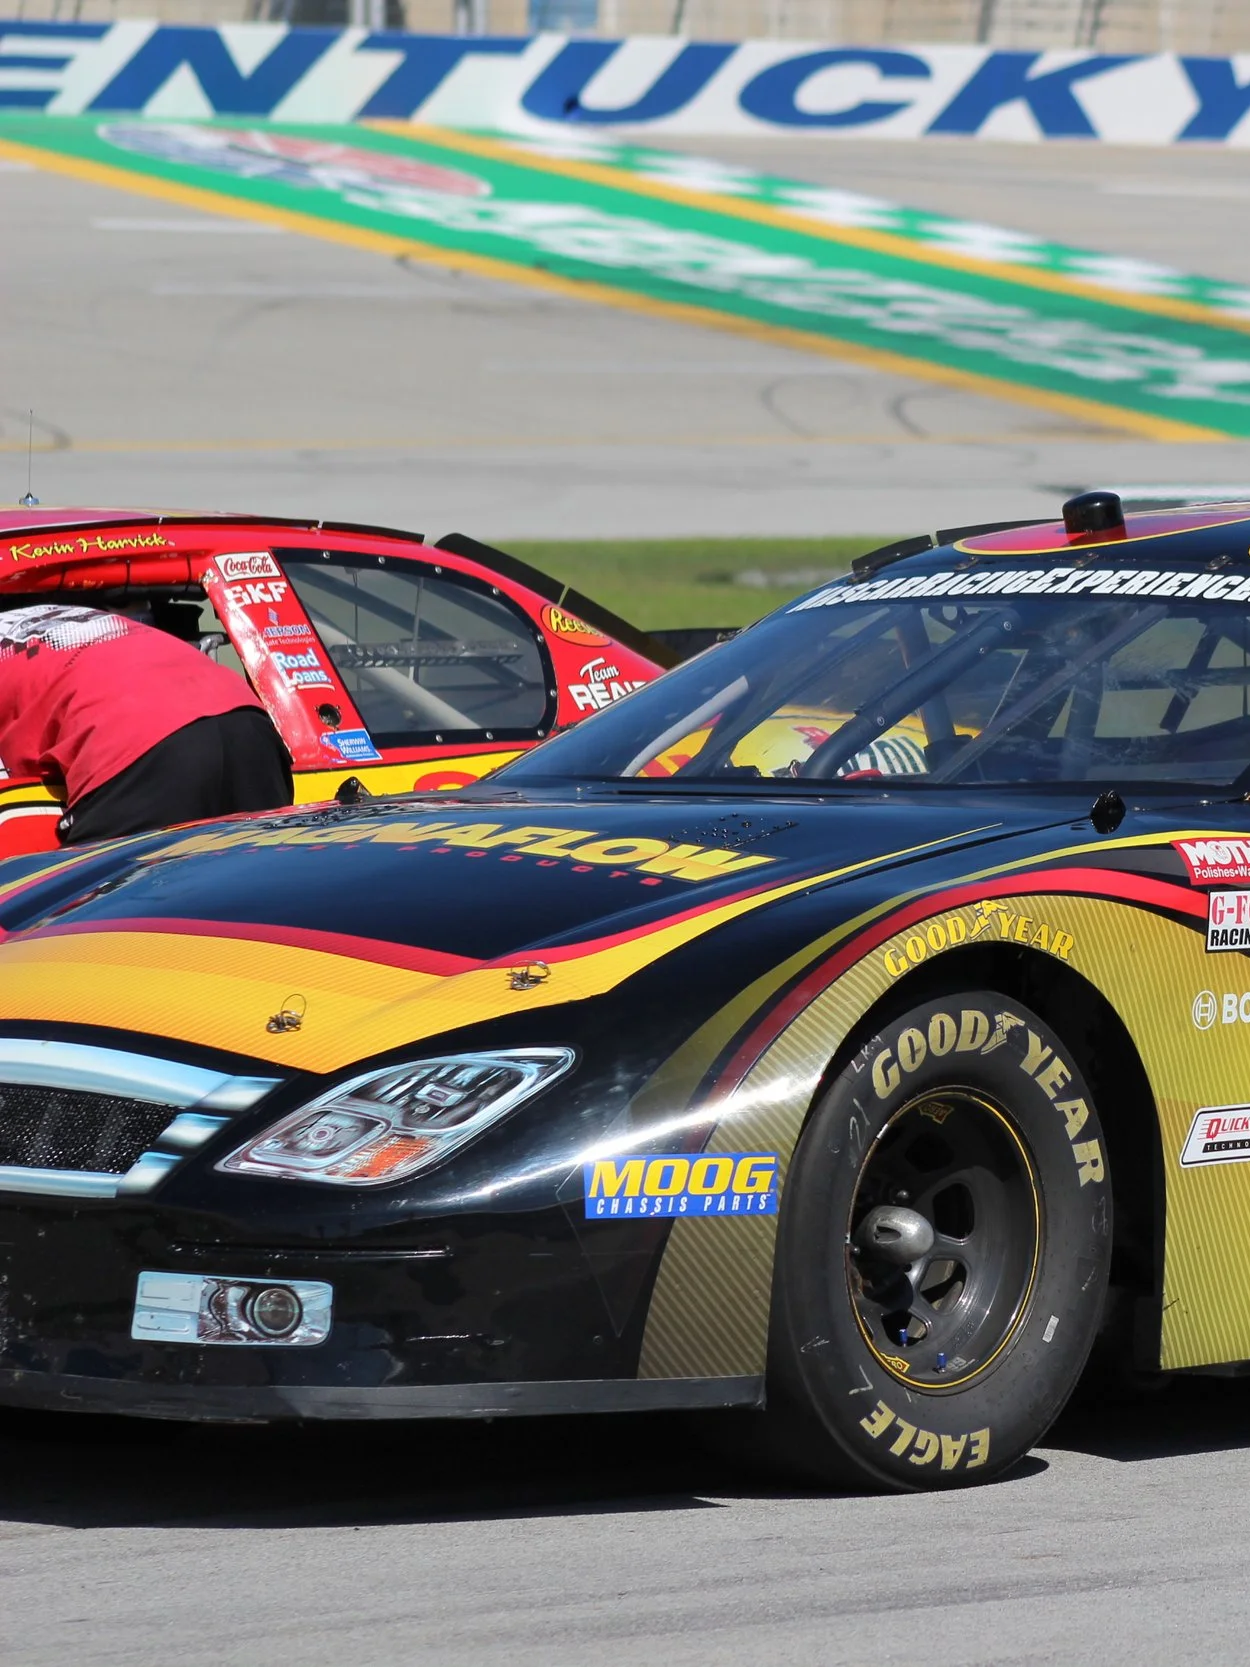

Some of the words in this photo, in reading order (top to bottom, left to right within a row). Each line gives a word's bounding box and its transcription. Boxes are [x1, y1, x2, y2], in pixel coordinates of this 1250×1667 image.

[9, 543, 74, 561] Kevin
[76, 533, 167, 553] Harvick
[271, 647, 320, 671] Road
[579, 656, 620, 684] Team
[1205, 1117, 1250, 1140] QUICK
[588, 1156, 776, 1198] MOOG
[596, 1197, 688, 1215] CHASSIS
[703, 1194, 767, 1212] PARTS
[860, 1400, 990, 1470] EAGLE
